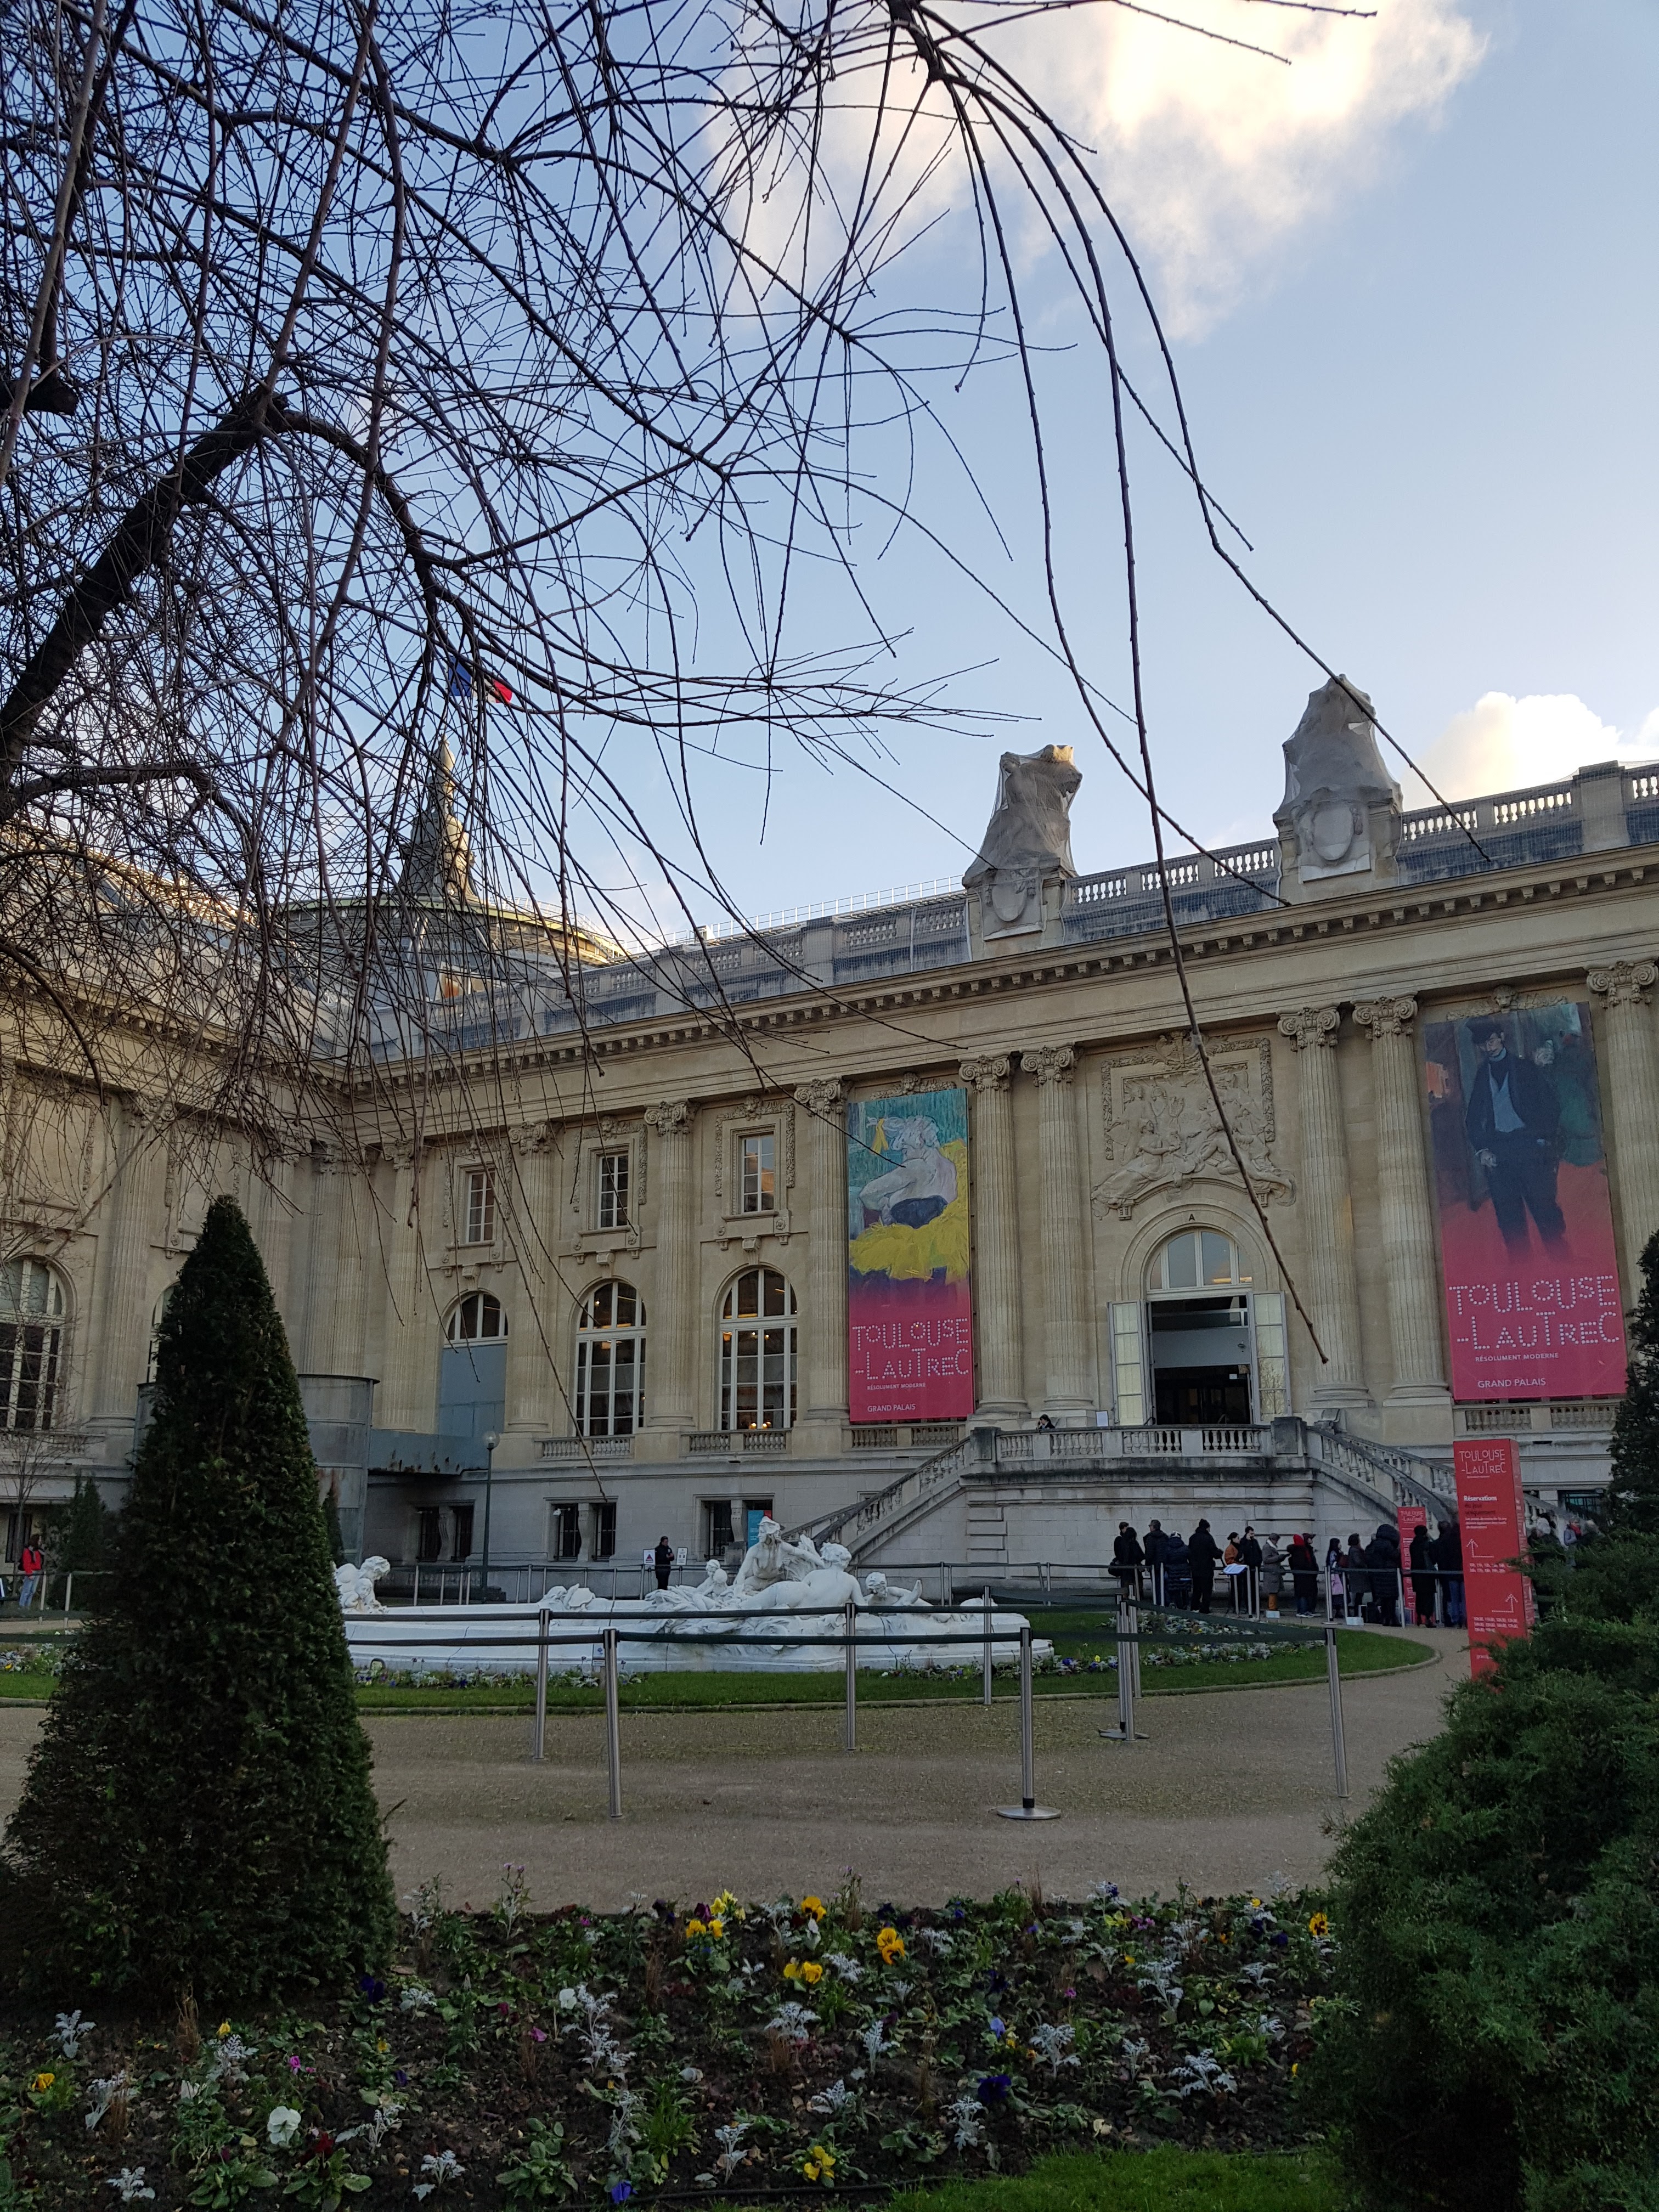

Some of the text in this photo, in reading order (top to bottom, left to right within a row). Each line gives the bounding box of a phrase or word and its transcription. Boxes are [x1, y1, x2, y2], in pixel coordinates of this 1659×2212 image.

[1449, 1275, 1616, 1315] TOULOUSE
[852, 1318, 968, 1351] TOULOUSE
[1477, 1378, 1546, 1388] GRAND PALAIS
[867, 1403, 916, 1412] GRAND PALAIS
[1459, 1449, 1505, 1462] TOULOUSE
